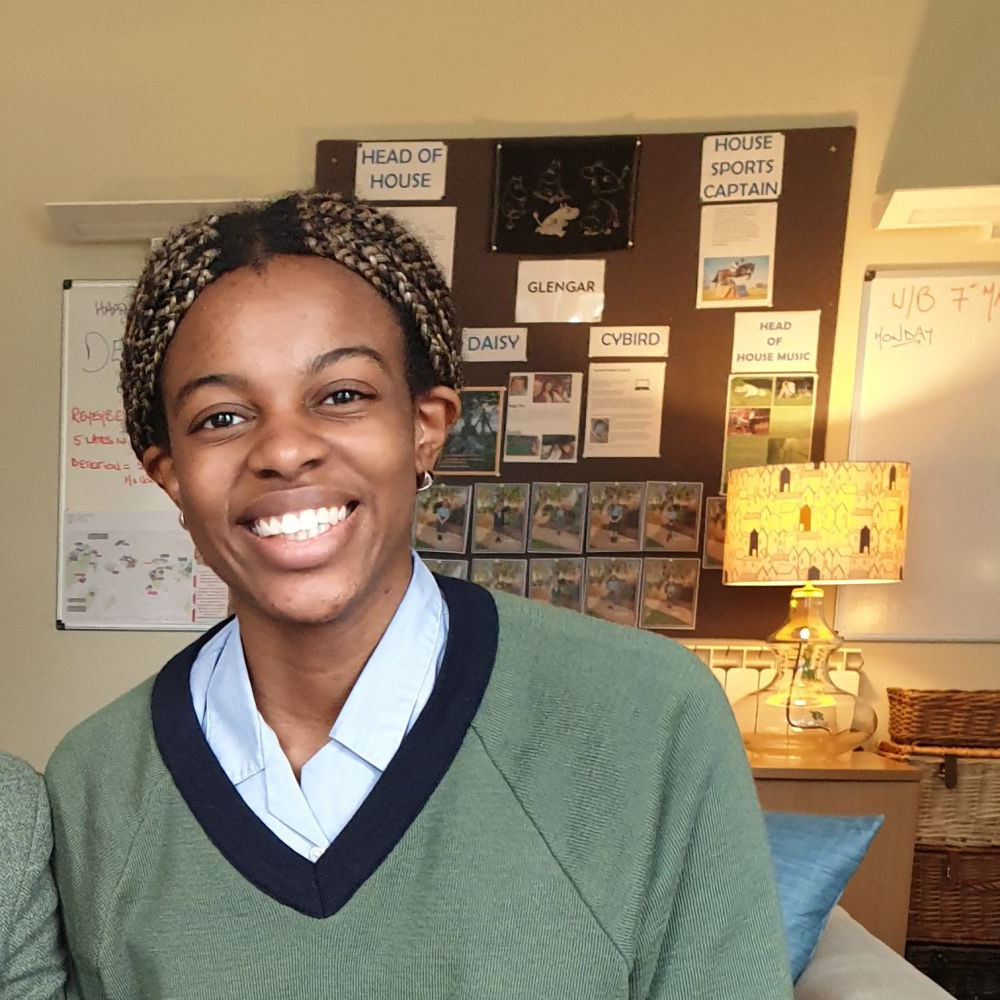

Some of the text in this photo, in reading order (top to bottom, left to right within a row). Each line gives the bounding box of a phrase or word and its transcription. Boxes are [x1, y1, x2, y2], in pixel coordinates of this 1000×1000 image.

[714, 135, 773, 152] HOUSE
[361, 147, 443, 165] HEAD OF
[711, 159, 774, 176] SPORTS
[370, 172, 431, 189] HOUSE
[703, 181, 778, 199] CAPTAIN
[527, 281, 595, 293] GLENGAR
[759, 321, 793, 331] HEAD
[468, 334, 520, 351] DAISY
[601, 332, 660, 347] CYBIRD
[767, 336, 783, 347] OF
[736, 351, 811, 362] HOUSE MUSIC
